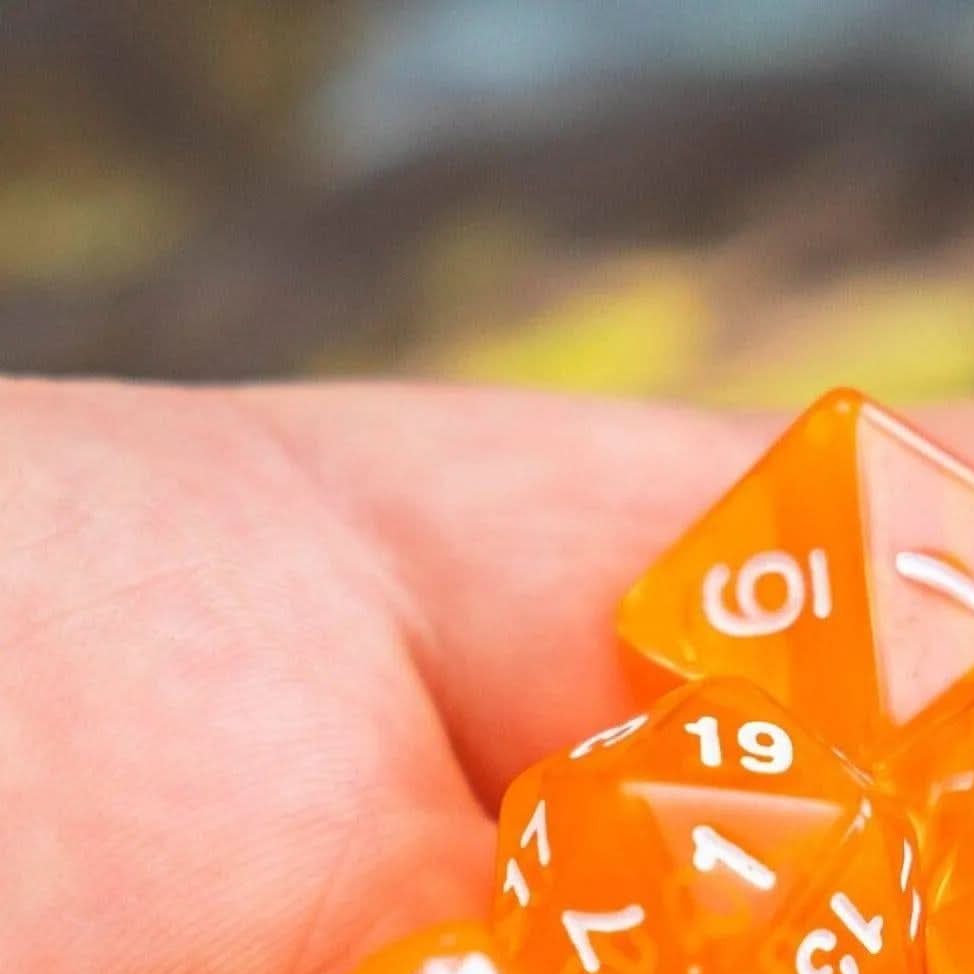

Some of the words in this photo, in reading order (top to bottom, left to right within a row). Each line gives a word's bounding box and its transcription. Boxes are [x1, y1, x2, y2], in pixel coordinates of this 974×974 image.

[684, 716, 794, 773] 19
[692, 825, 778, 890] 1
[561, 904, 645, 973] 7
